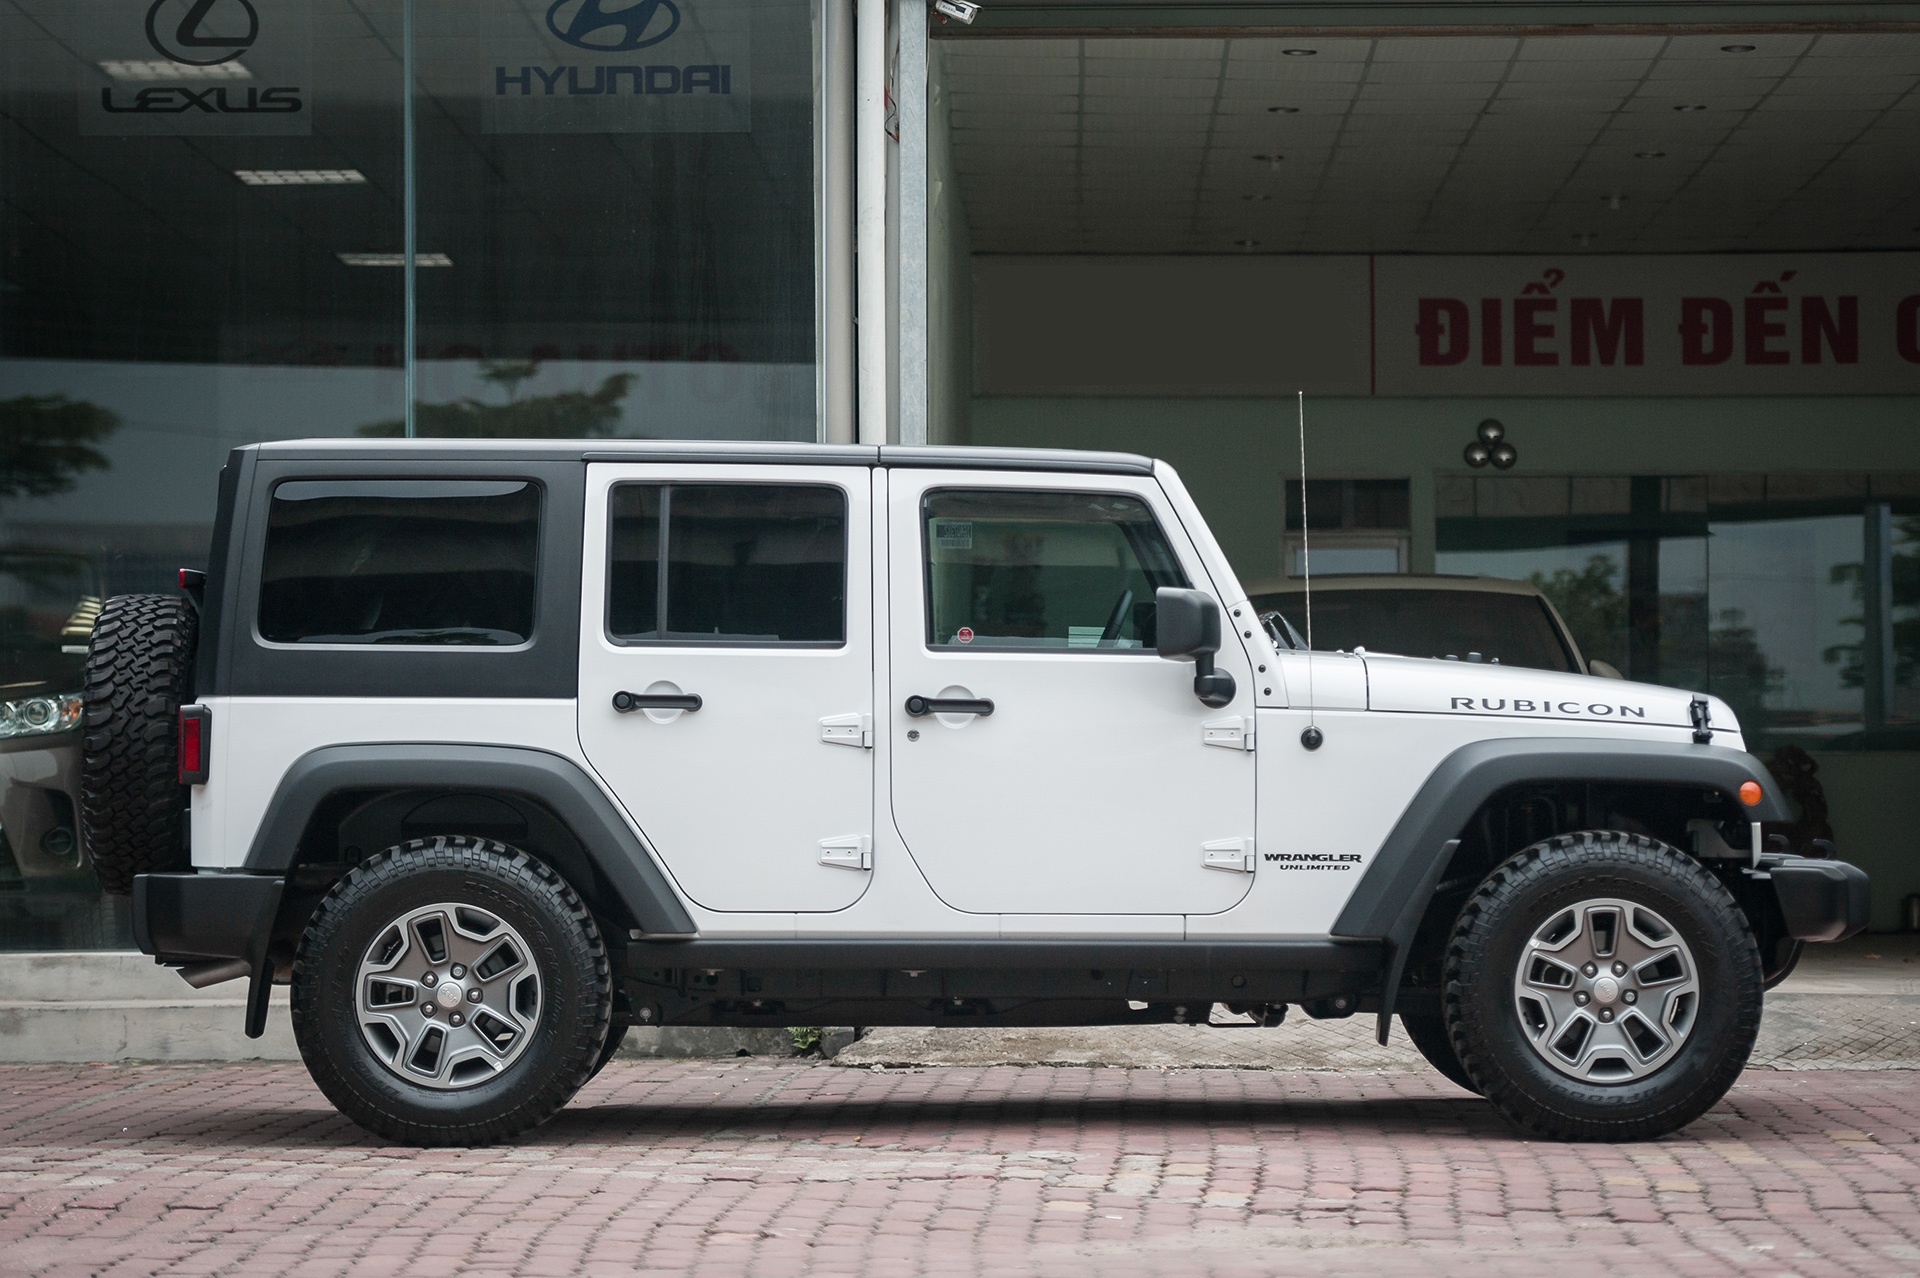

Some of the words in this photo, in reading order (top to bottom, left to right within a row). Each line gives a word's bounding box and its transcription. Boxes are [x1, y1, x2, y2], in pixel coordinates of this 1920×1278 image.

[495, 64, 731, 96] HYUNDAI
[101, 87, 303, 114] LEXUS
[1415, 268, 1645, 367] ĐIỂM
[1678, 269, 1860, 366] ĐẾN
[1450, 697, 1646, 718] RUBICON
[1264, 853, 1363, 863] WRANGLER
